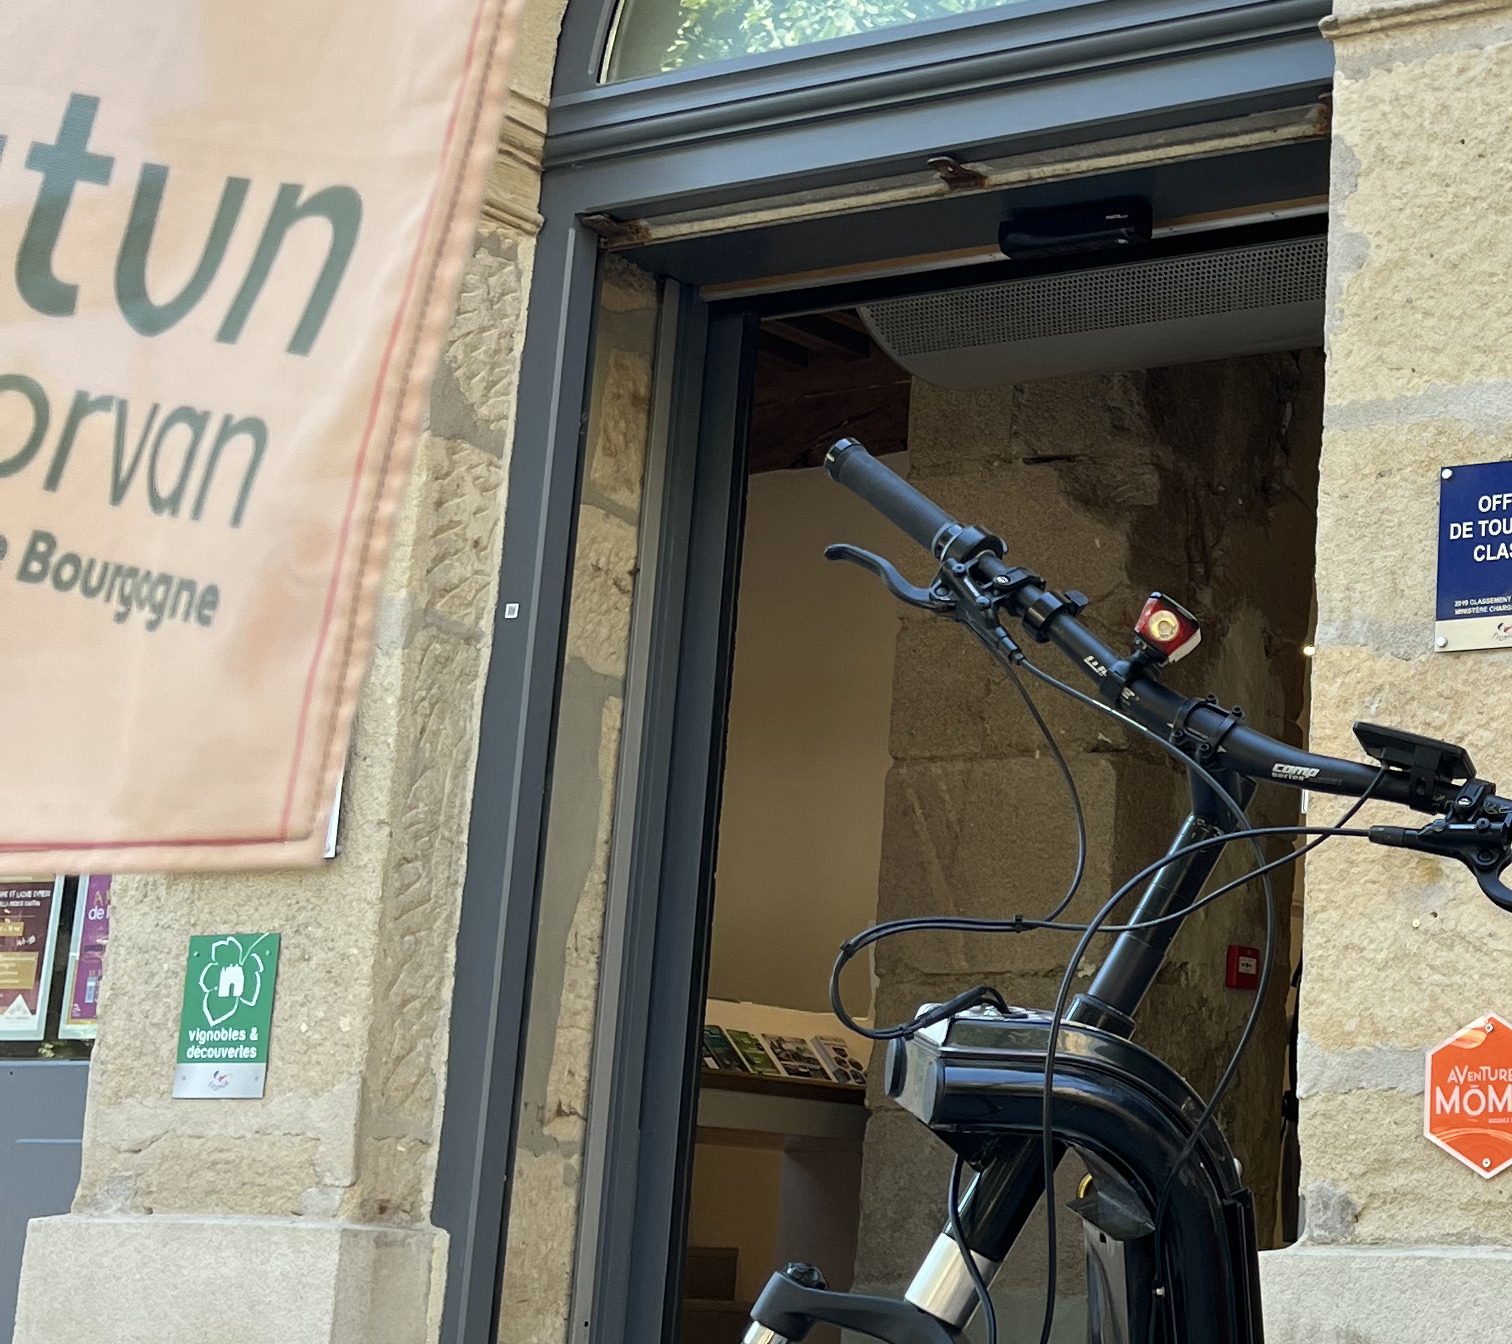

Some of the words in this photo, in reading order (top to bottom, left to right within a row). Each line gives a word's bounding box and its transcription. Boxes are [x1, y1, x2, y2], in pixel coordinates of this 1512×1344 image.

[0, 93, 363, 356] tun
[1449, 522, 1473, 540] DE
[16, 529, 219, 632] Bourgogne
[189, 1027, 246, 1045] vignobles
[250, 1027, 258, 1040] &
[187, 1045, 257, 1058] découvertes
